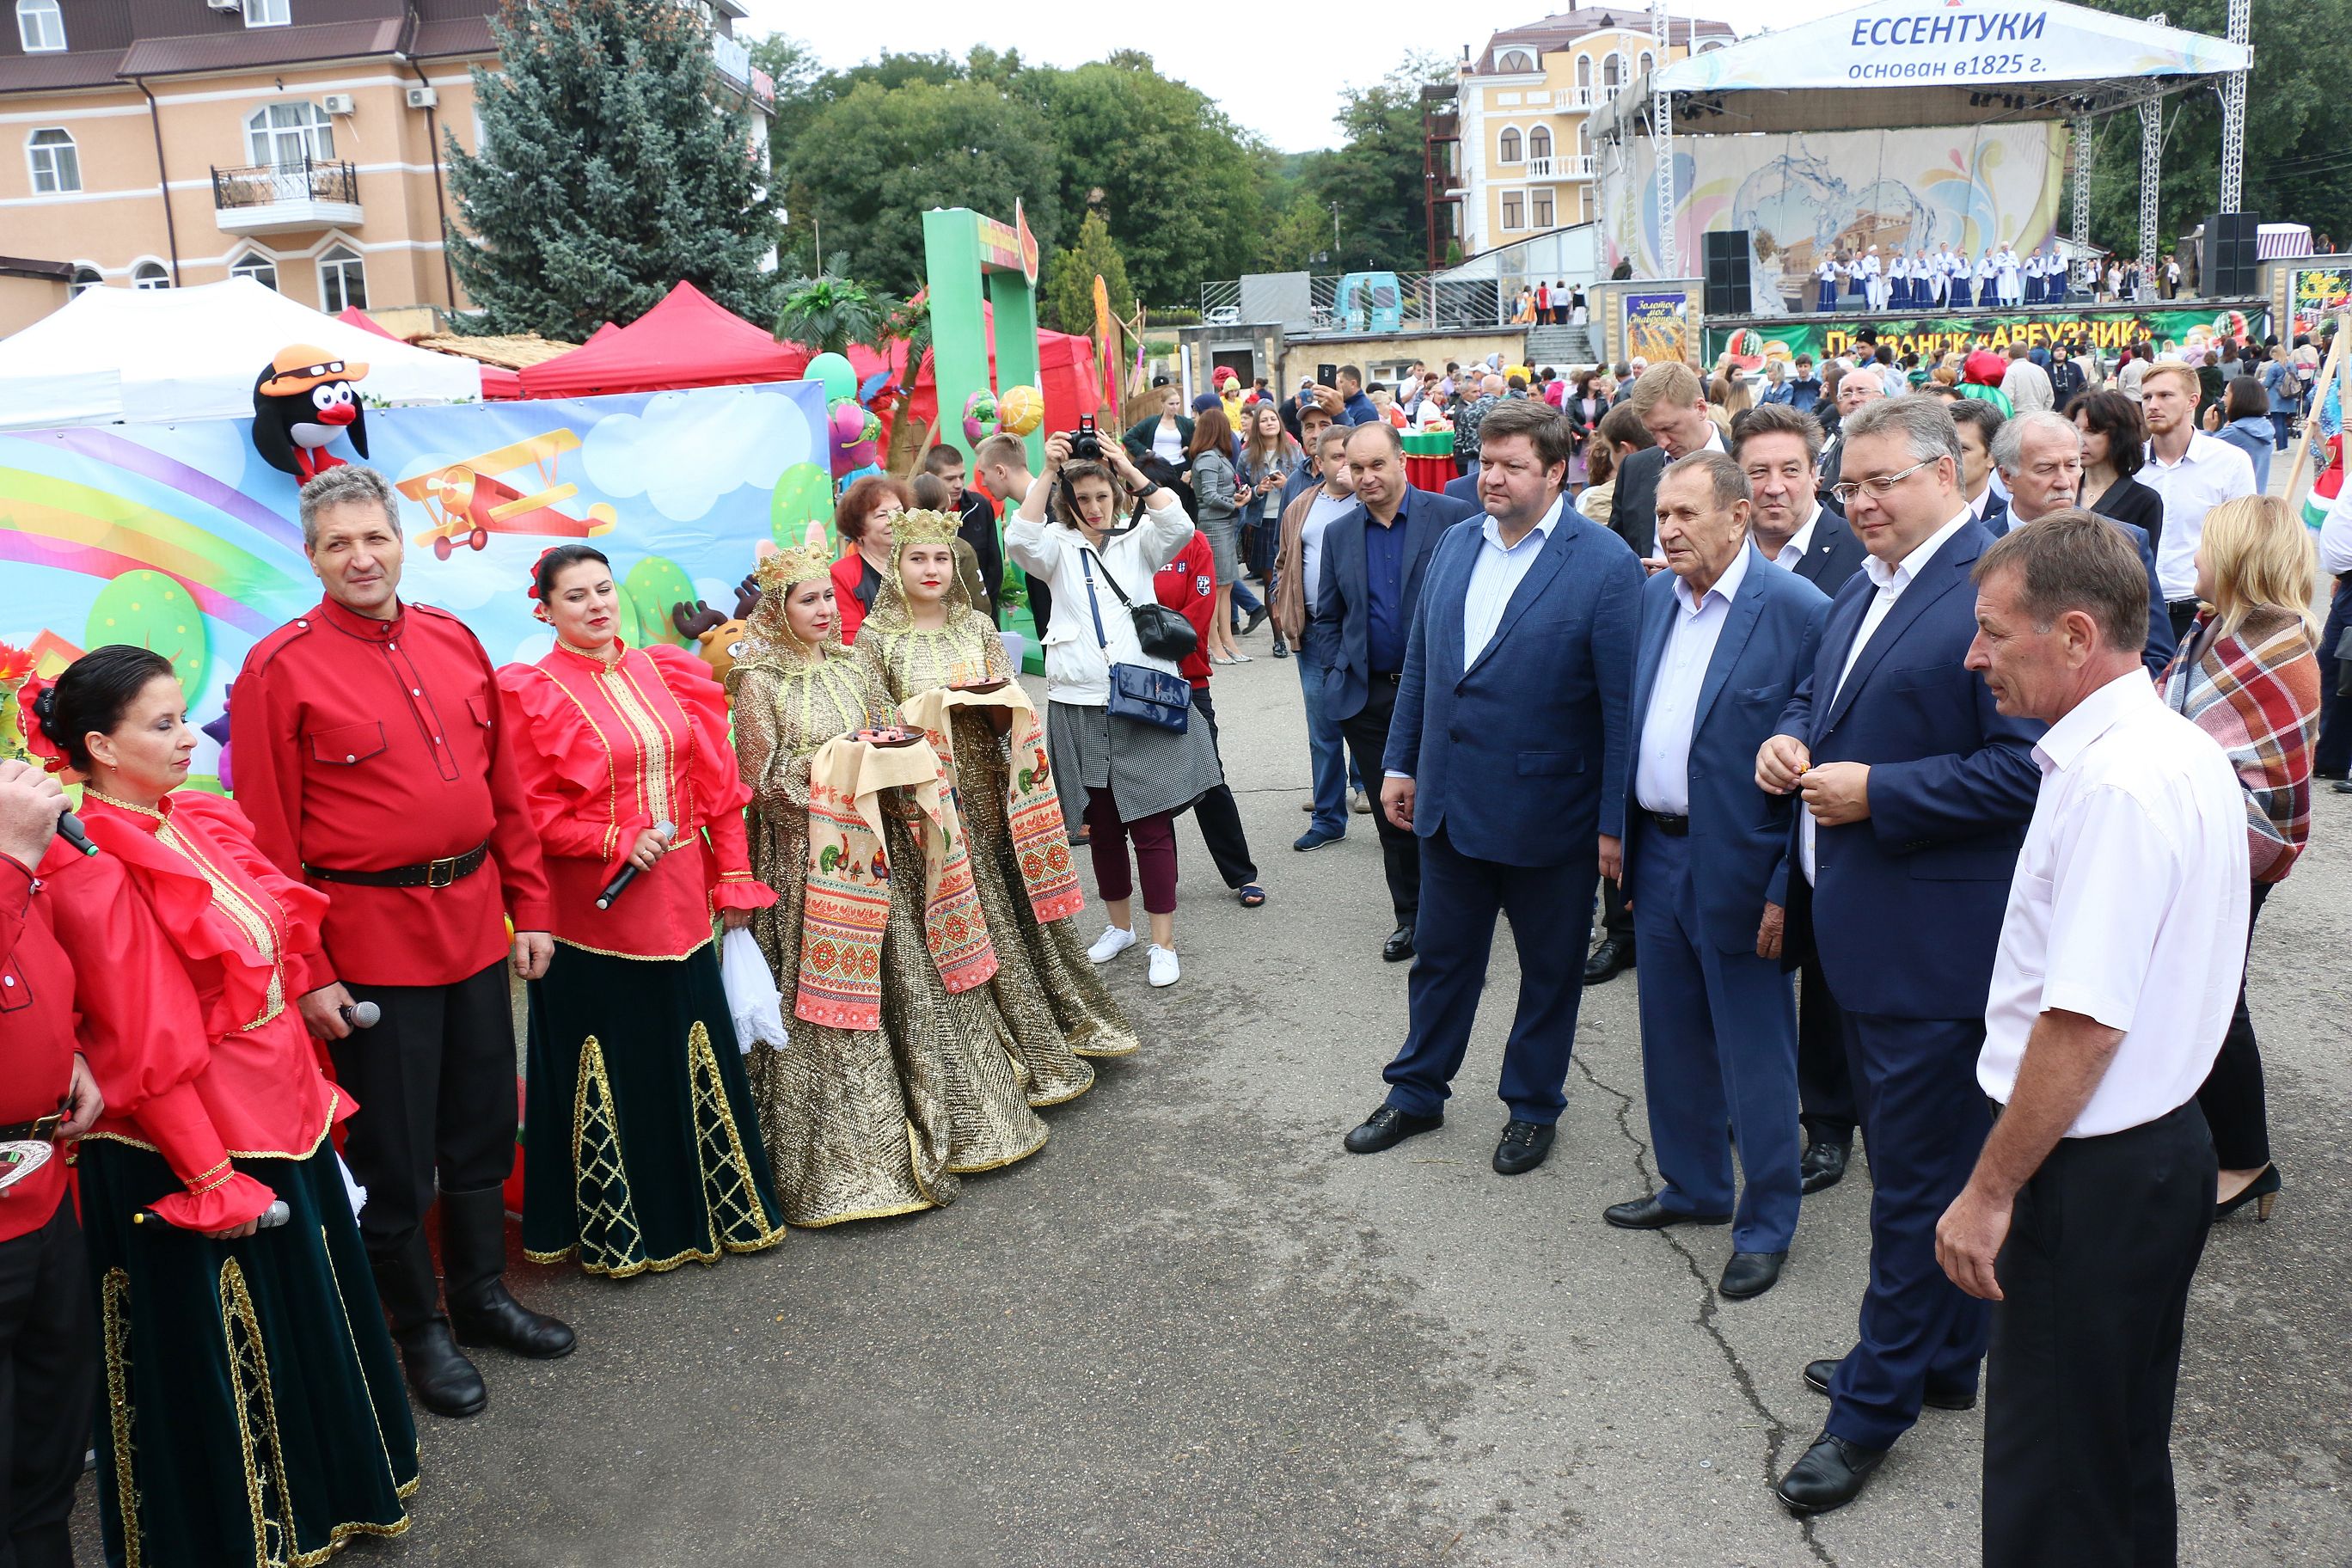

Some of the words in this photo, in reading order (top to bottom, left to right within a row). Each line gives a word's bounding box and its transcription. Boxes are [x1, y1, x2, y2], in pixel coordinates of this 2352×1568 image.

[1851, 11, 2047, 46] ЕССЕНТУКИ
[1848, 62, 1946, 79] основан
[2030, 57, 2047, 72] г.
[1637, 299, 1675, 309] Золотое
[1629, 315, 1684, 326] Ставрополье
